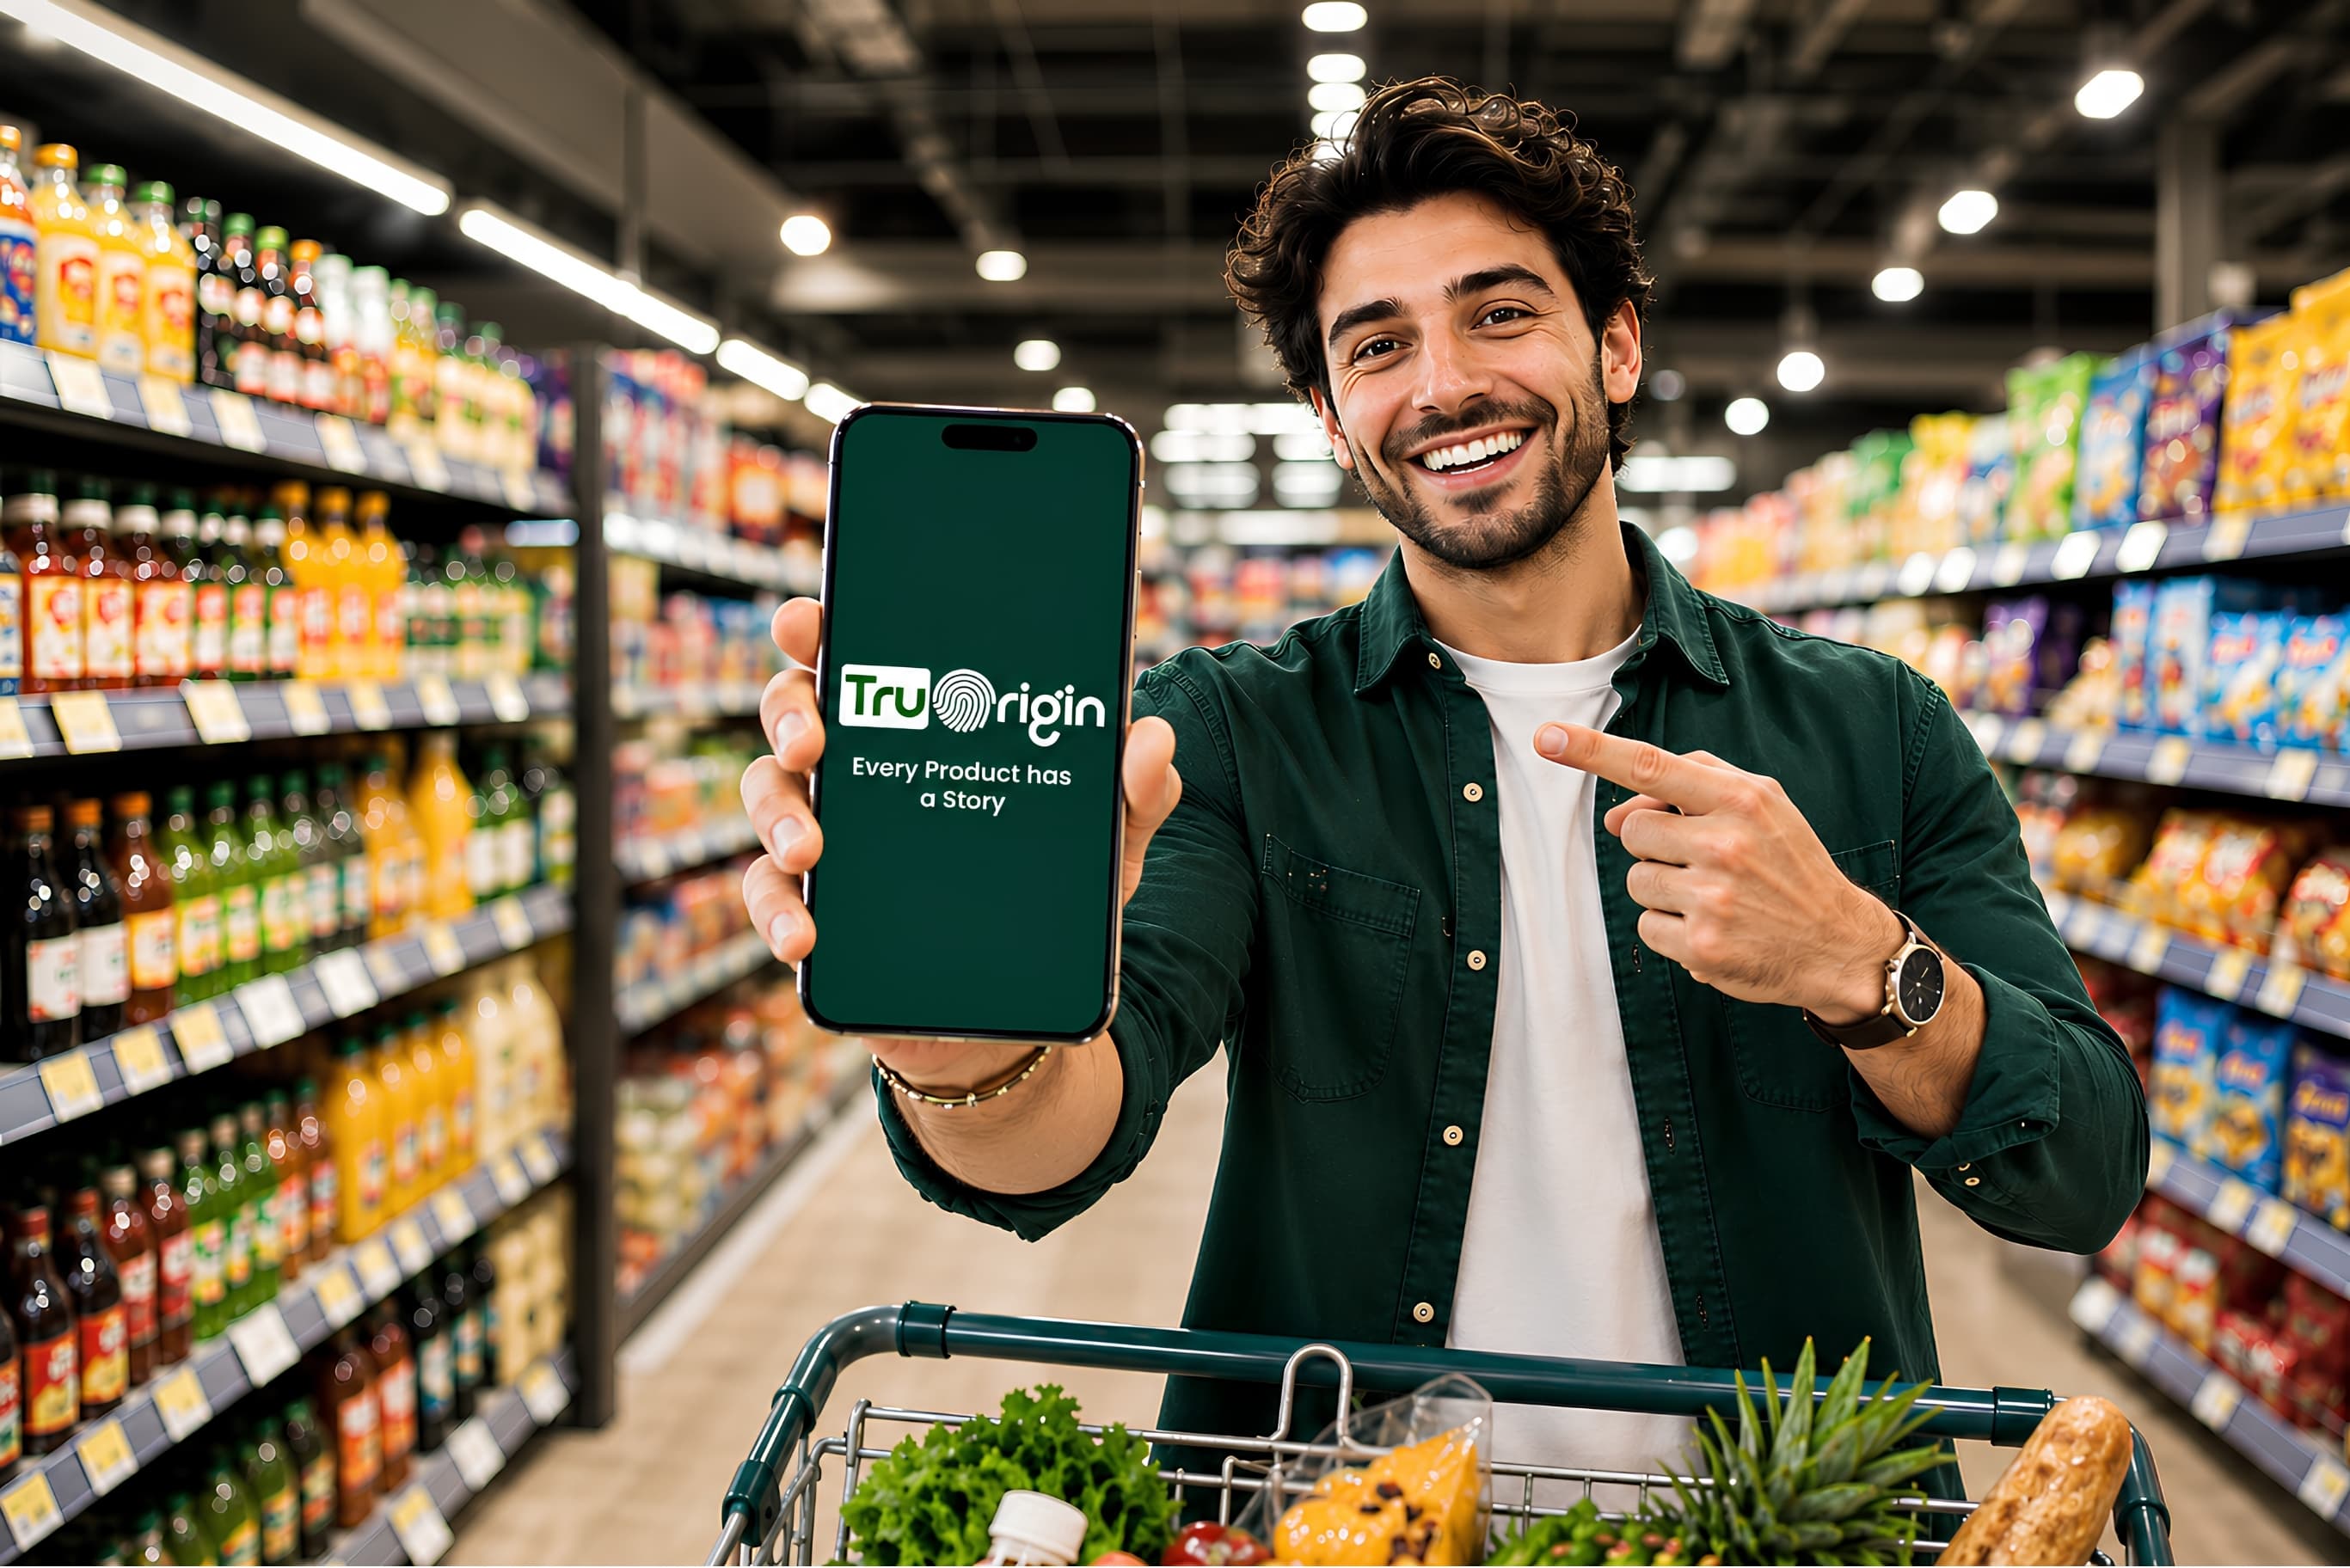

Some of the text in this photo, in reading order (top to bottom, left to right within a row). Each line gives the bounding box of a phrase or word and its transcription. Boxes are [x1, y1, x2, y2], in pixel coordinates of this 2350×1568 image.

[852, 756, 1071, 786] Every Product has
[920, 790, 1006, 817] a Story
